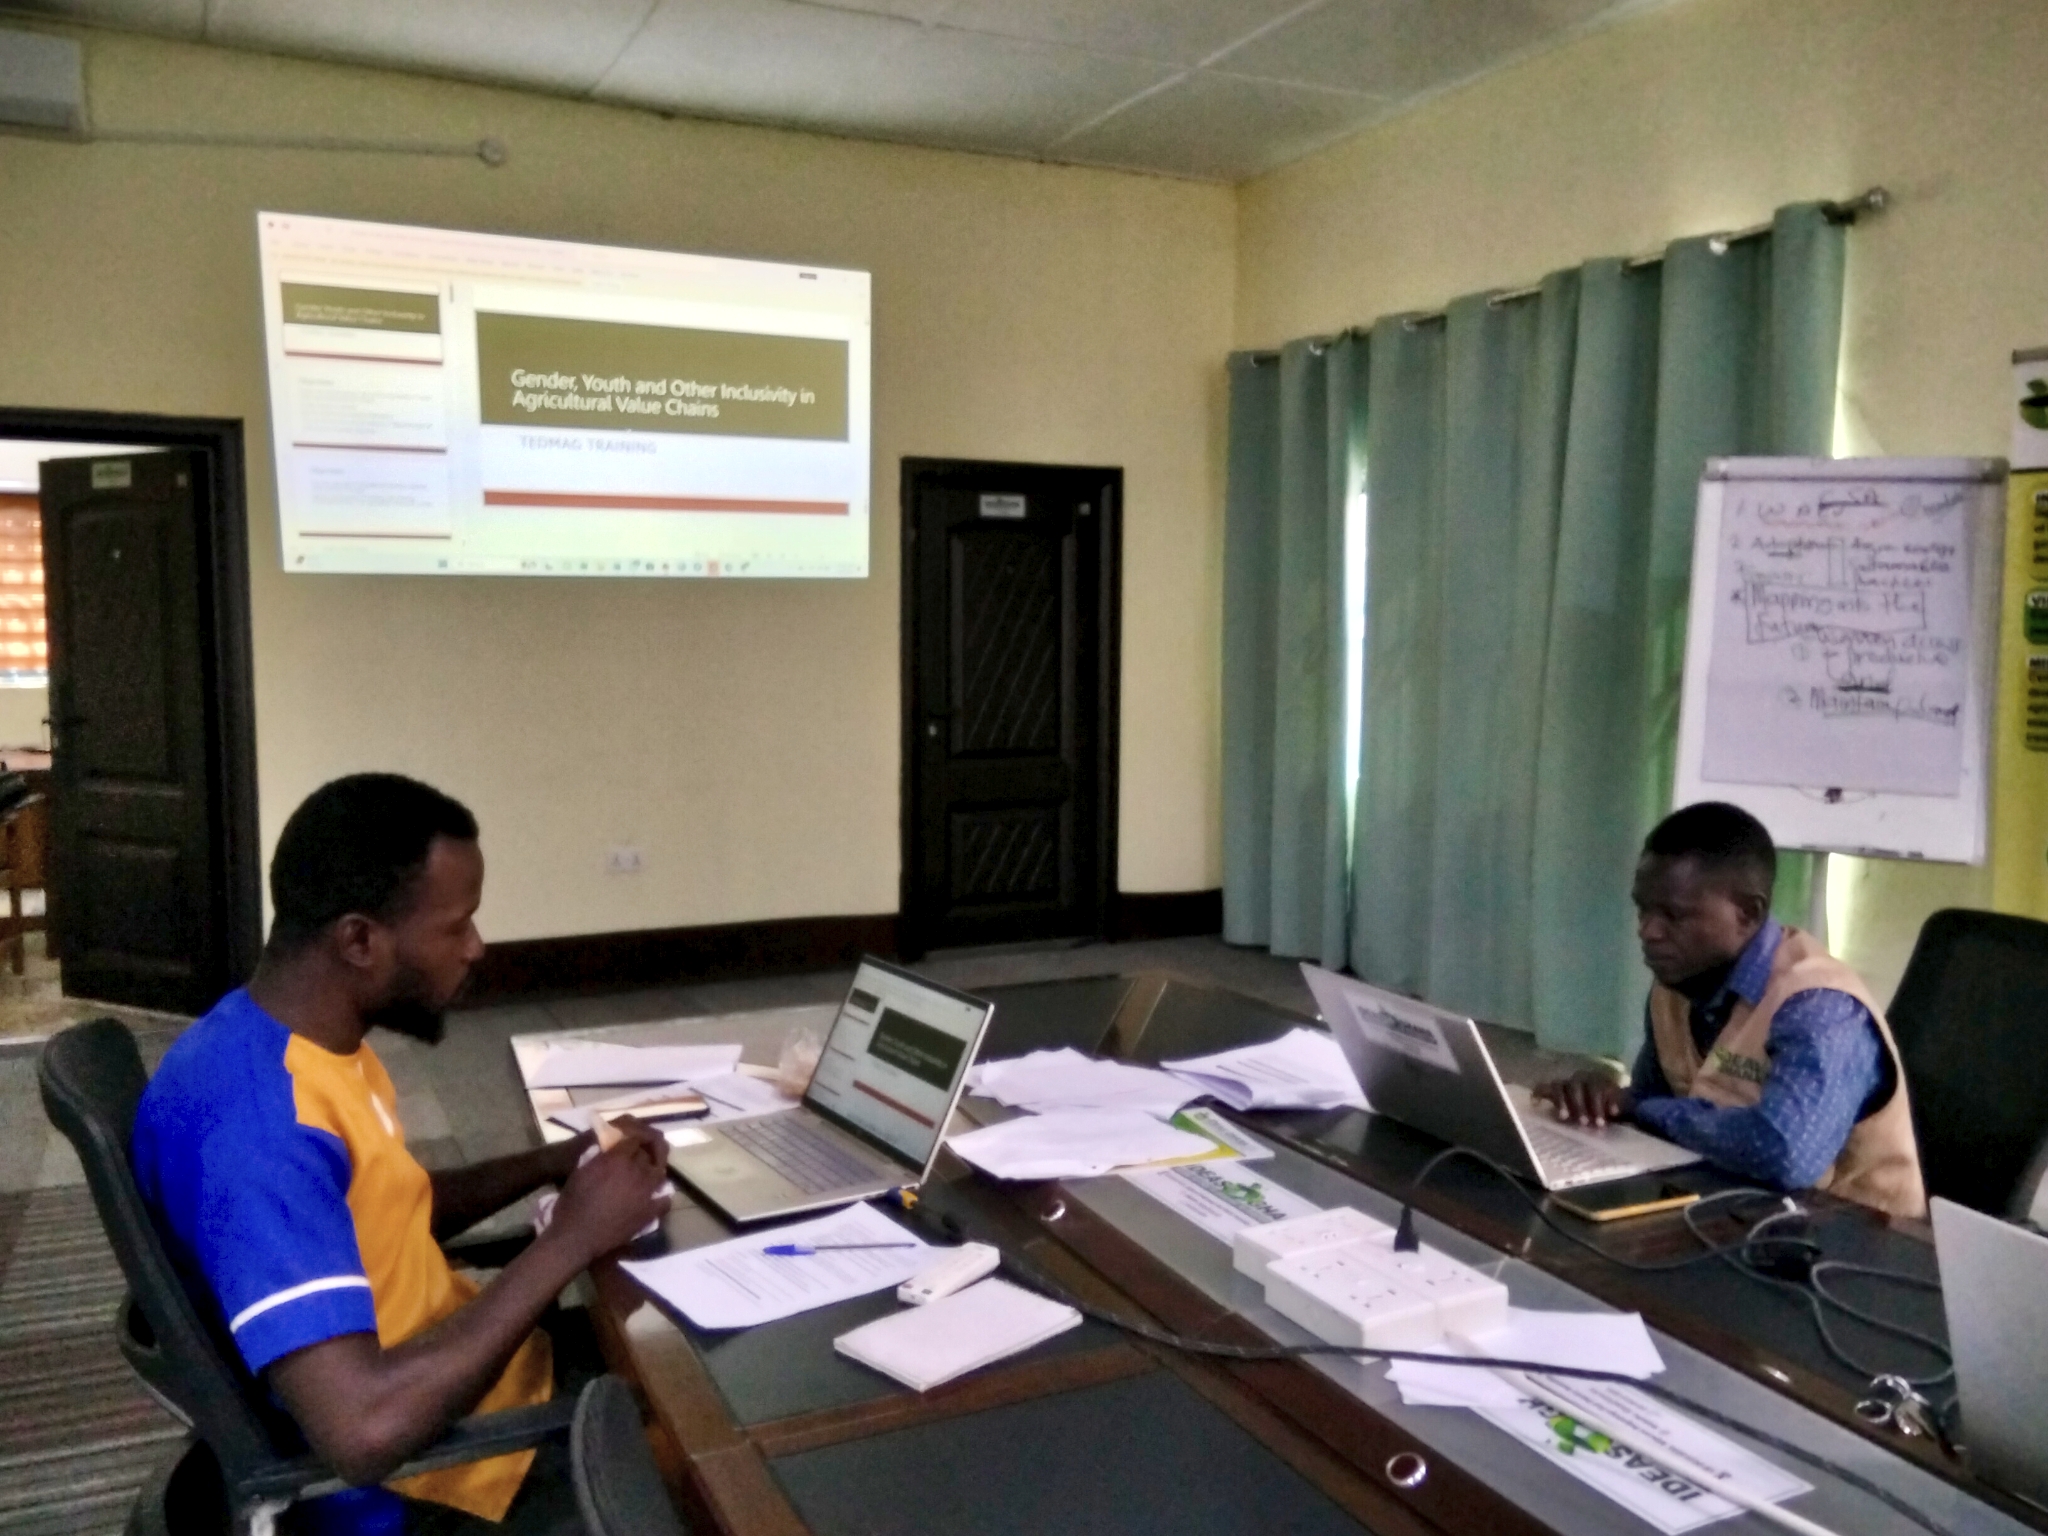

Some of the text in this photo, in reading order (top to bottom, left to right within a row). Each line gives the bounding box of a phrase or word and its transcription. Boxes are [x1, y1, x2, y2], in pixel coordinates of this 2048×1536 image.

[510, 368, 816, 407] Gender, Youth and Other Inclusivity in
[512, 390, 720, 418] Agricultural Value Chains
[587, 437, 658, 455] TRAINING
